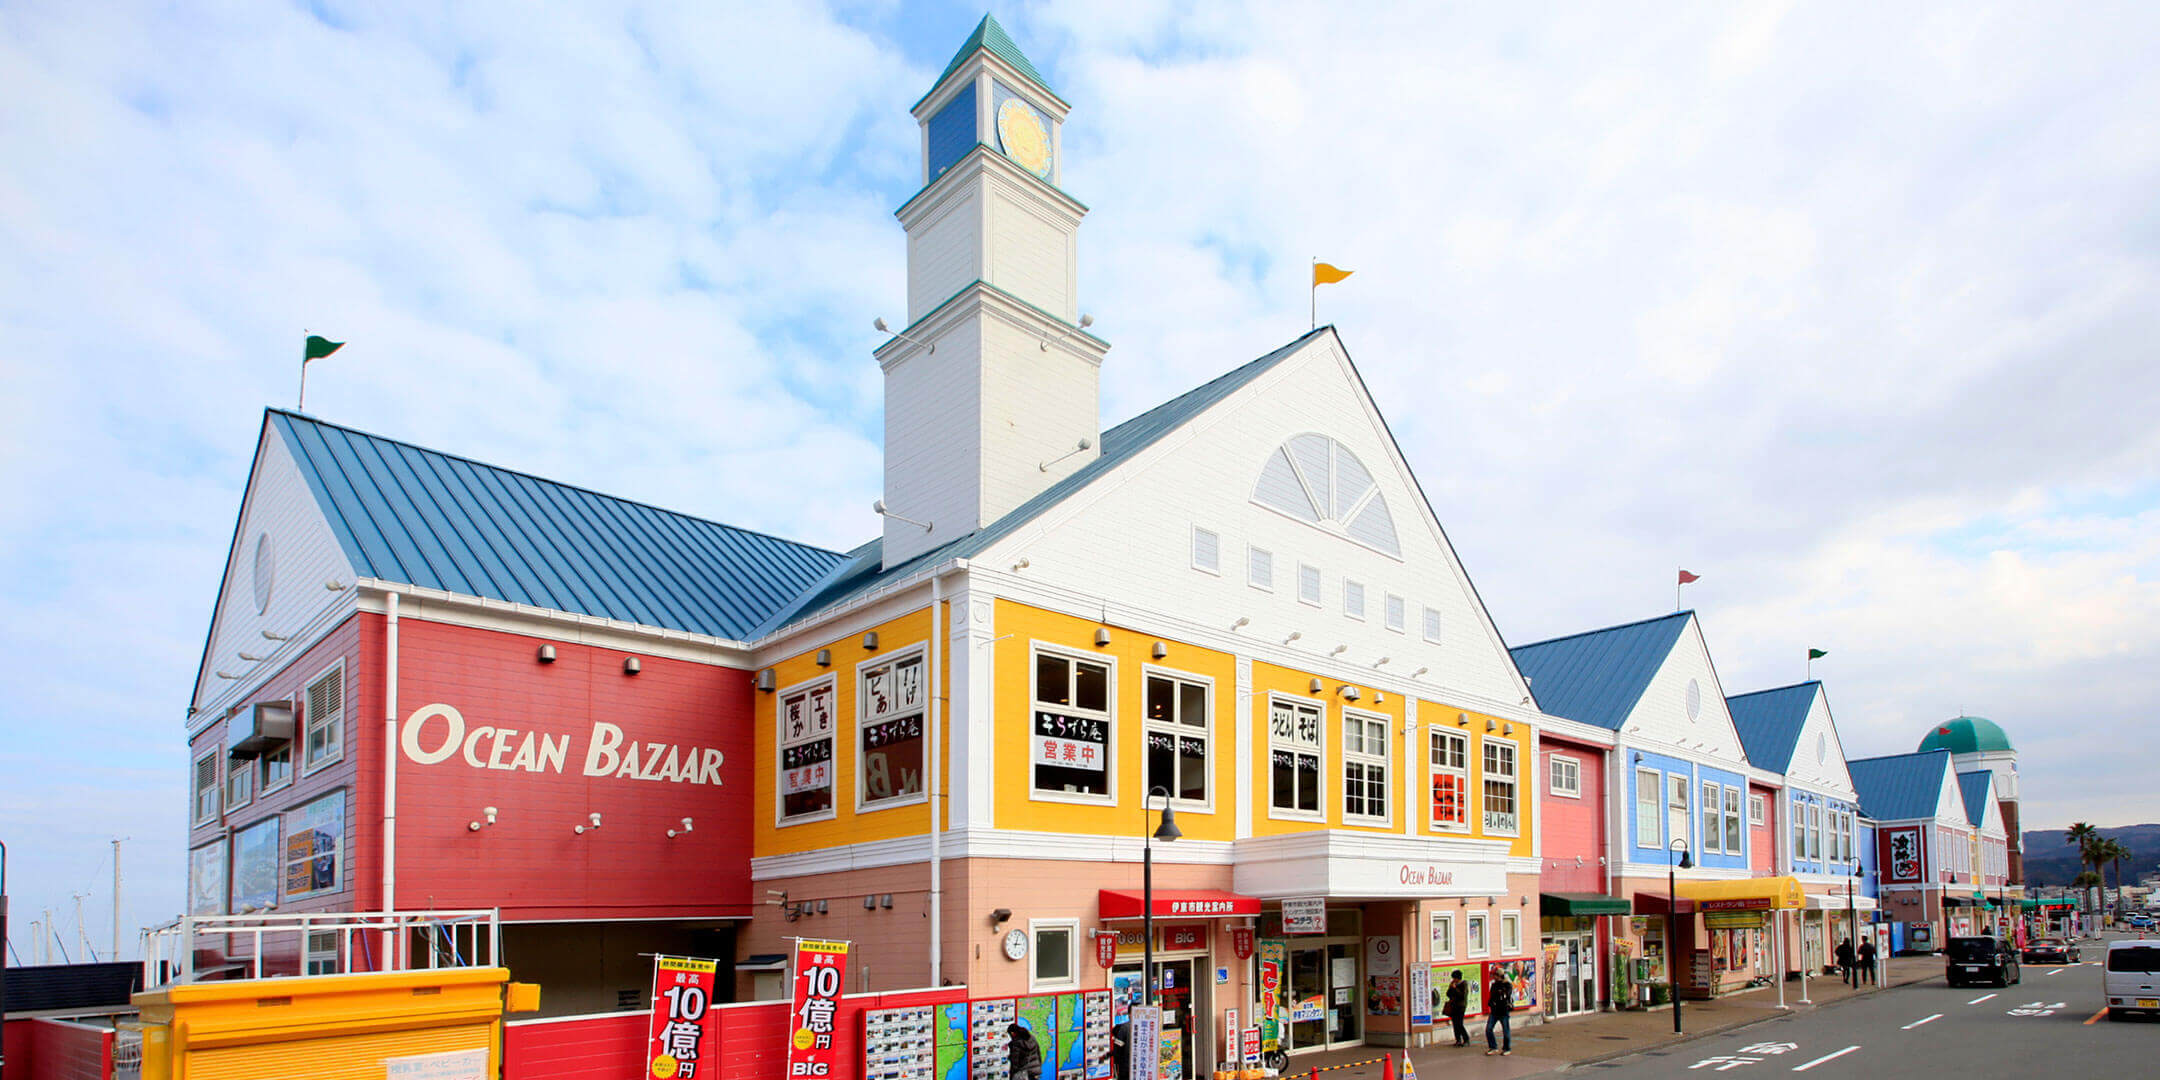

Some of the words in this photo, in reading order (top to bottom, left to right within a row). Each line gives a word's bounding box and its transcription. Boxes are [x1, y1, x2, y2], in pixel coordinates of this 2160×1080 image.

[1298, 717, 1316, 742] そば
[1043, 740, 1095, 764] 営業中
[789, 765, 825, 789] 営業中
[1172, 901, 1235, 914] 伊東市観光案内所
[1175, 931, 1196, 944] BIG
[813, 954, 834, 964] 最高
[675, 973, 699, 985] 最高
[791, 1062, 828, 1076] BIG
